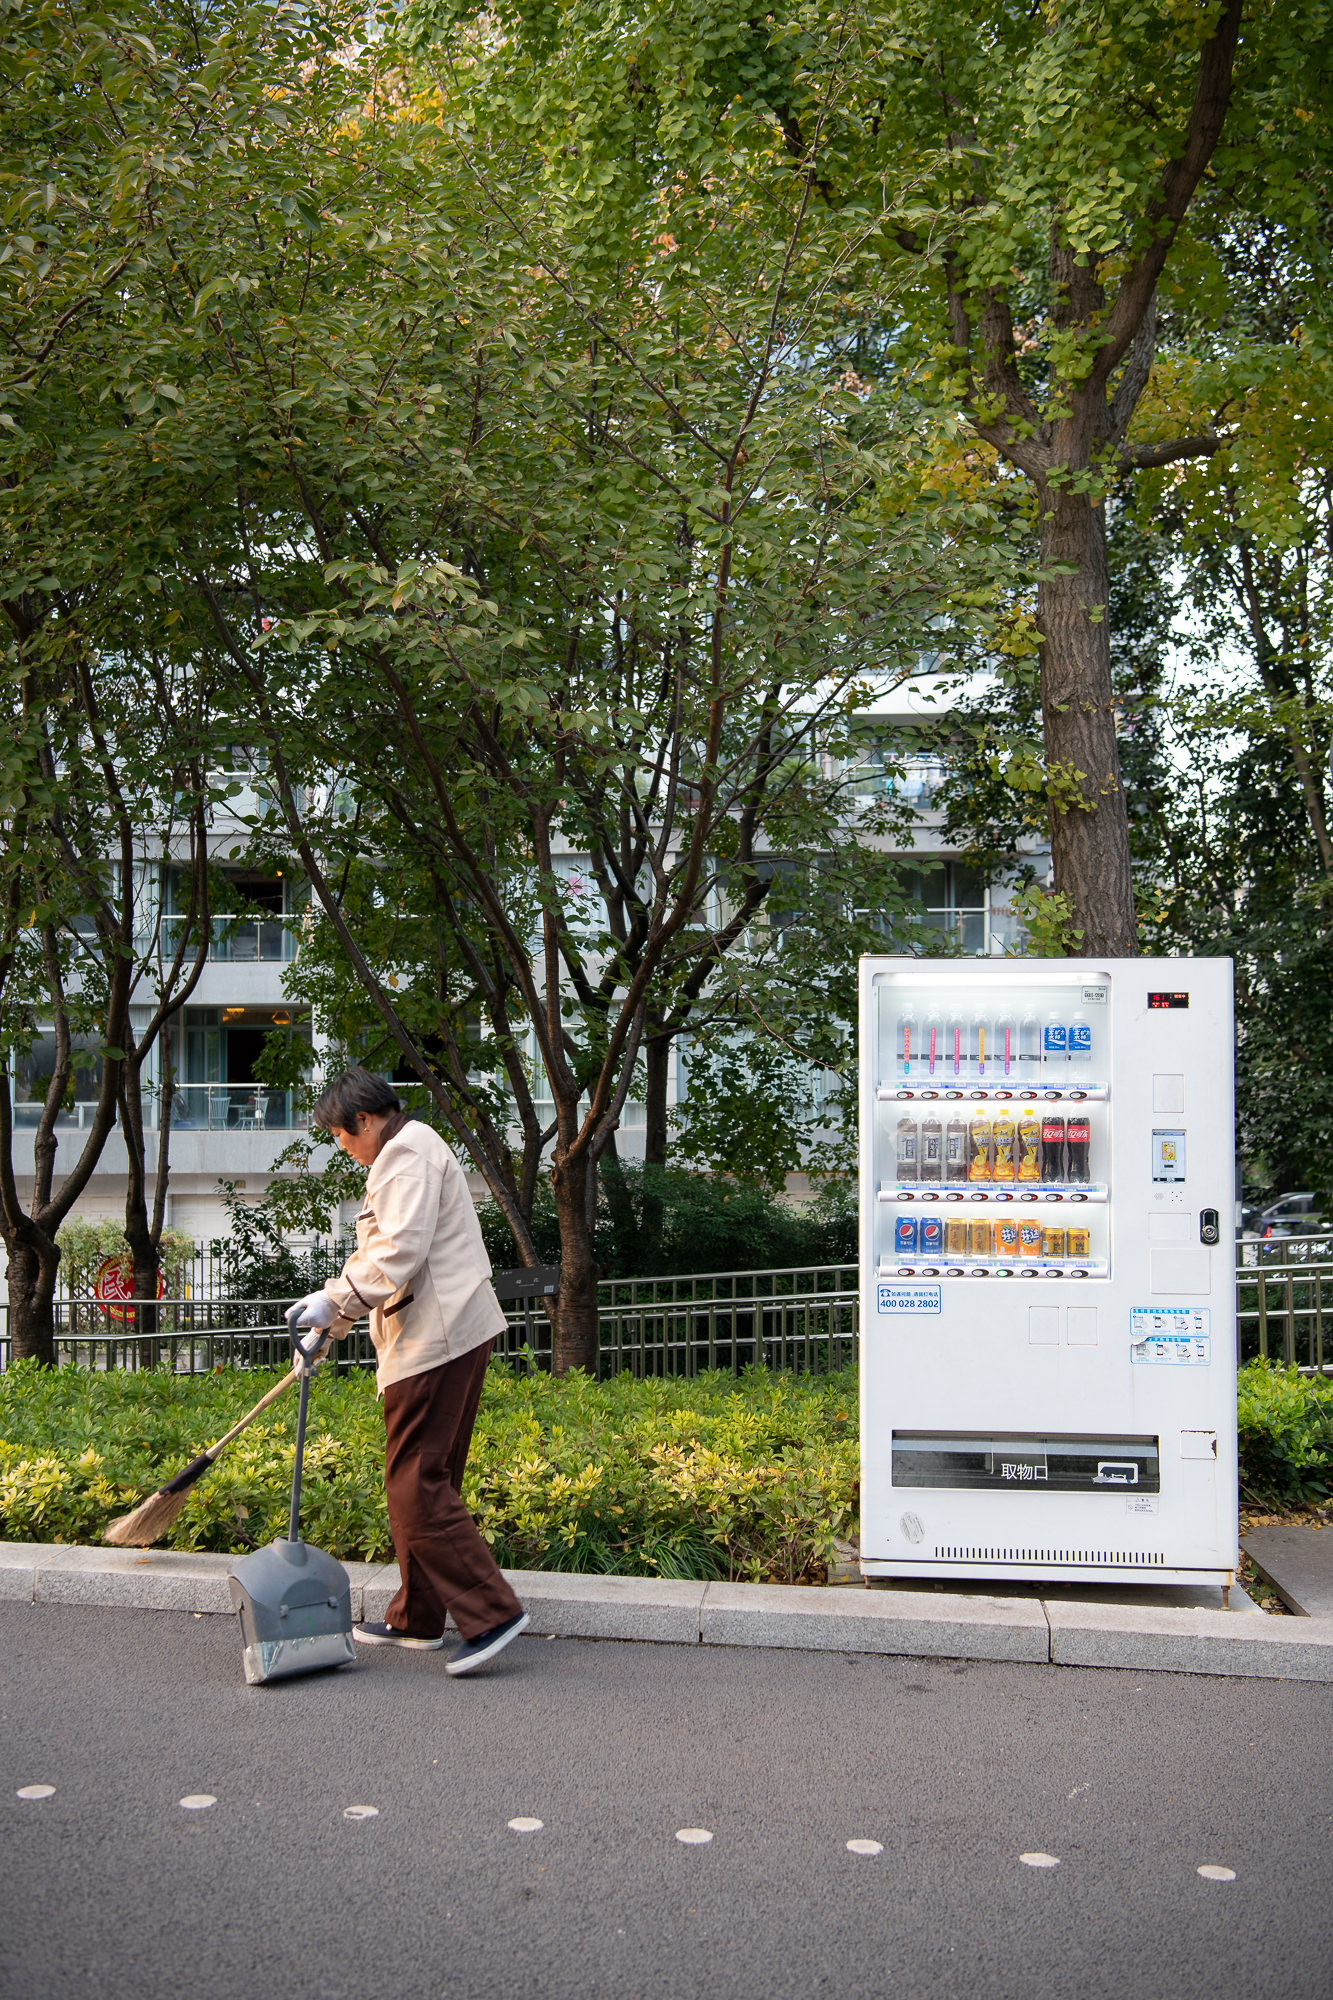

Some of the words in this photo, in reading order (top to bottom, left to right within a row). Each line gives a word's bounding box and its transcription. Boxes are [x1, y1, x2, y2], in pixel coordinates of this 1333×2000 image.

[880, 1300, 897, 1308] 400
[898, 1300, 916, 1308] 028
[917, 1300, 939, 1308] 2802
[1001, 1463, 1048, 1481] 取物口
